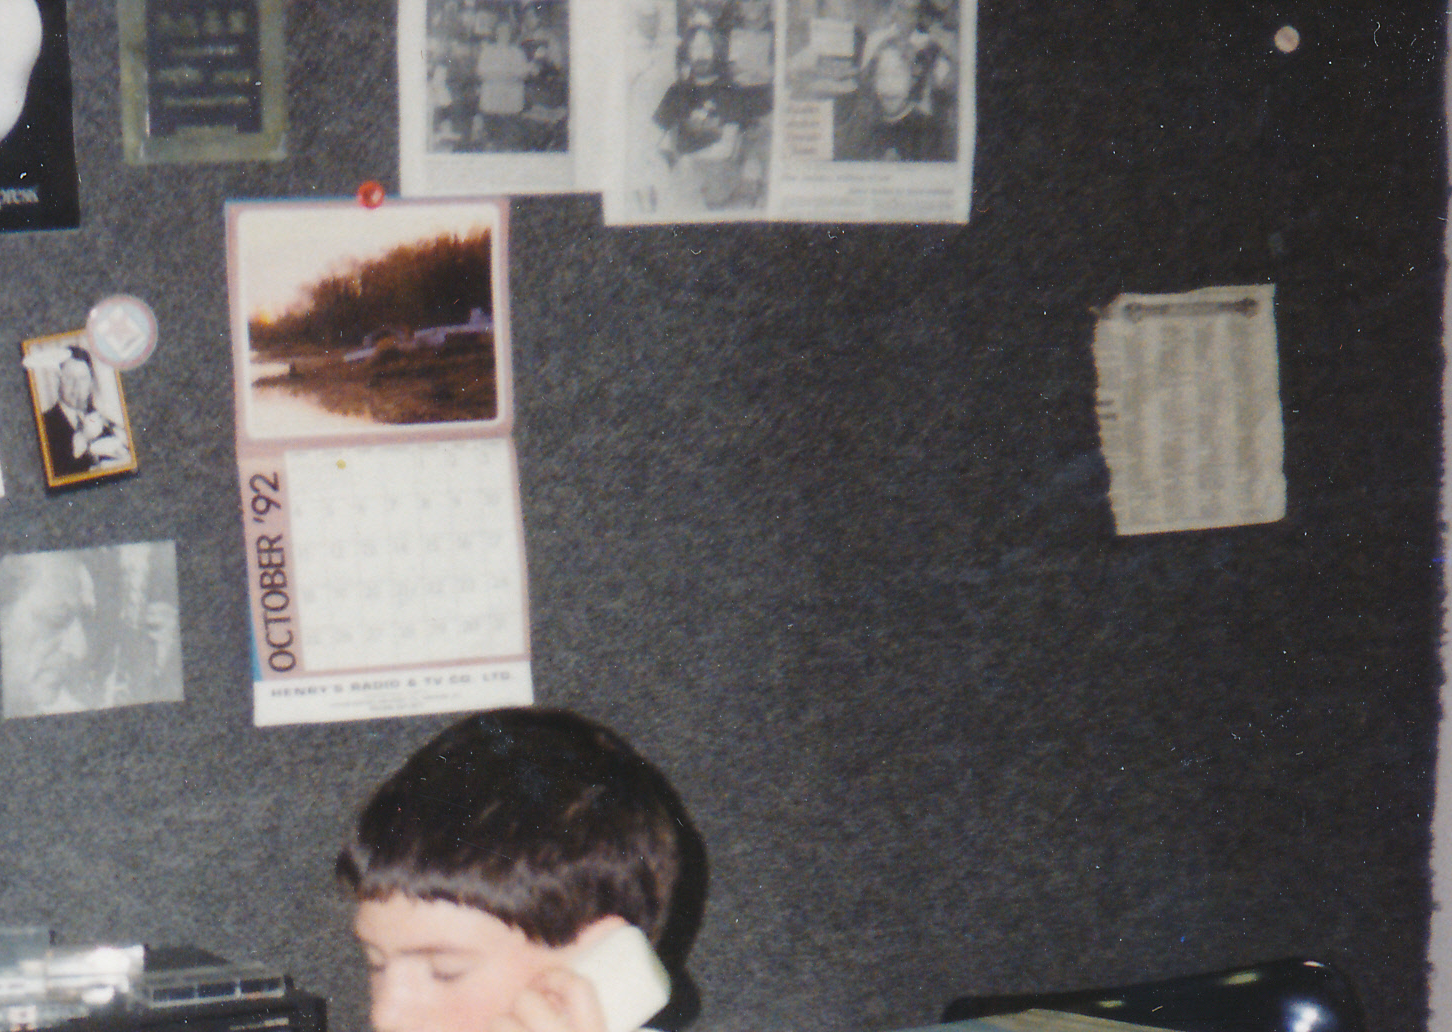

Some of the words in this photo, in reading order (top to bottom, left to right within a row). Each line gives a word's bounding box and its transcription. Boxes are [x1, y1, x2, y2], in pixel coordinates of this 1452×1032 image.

[249, 471, 281, 523] '92
[256, 534, 297, 673] OCTOBER
[350, 678, 400, 692] RADIO
[407, 678, 418, 688] &
[424, 675, 443, 687] TV
